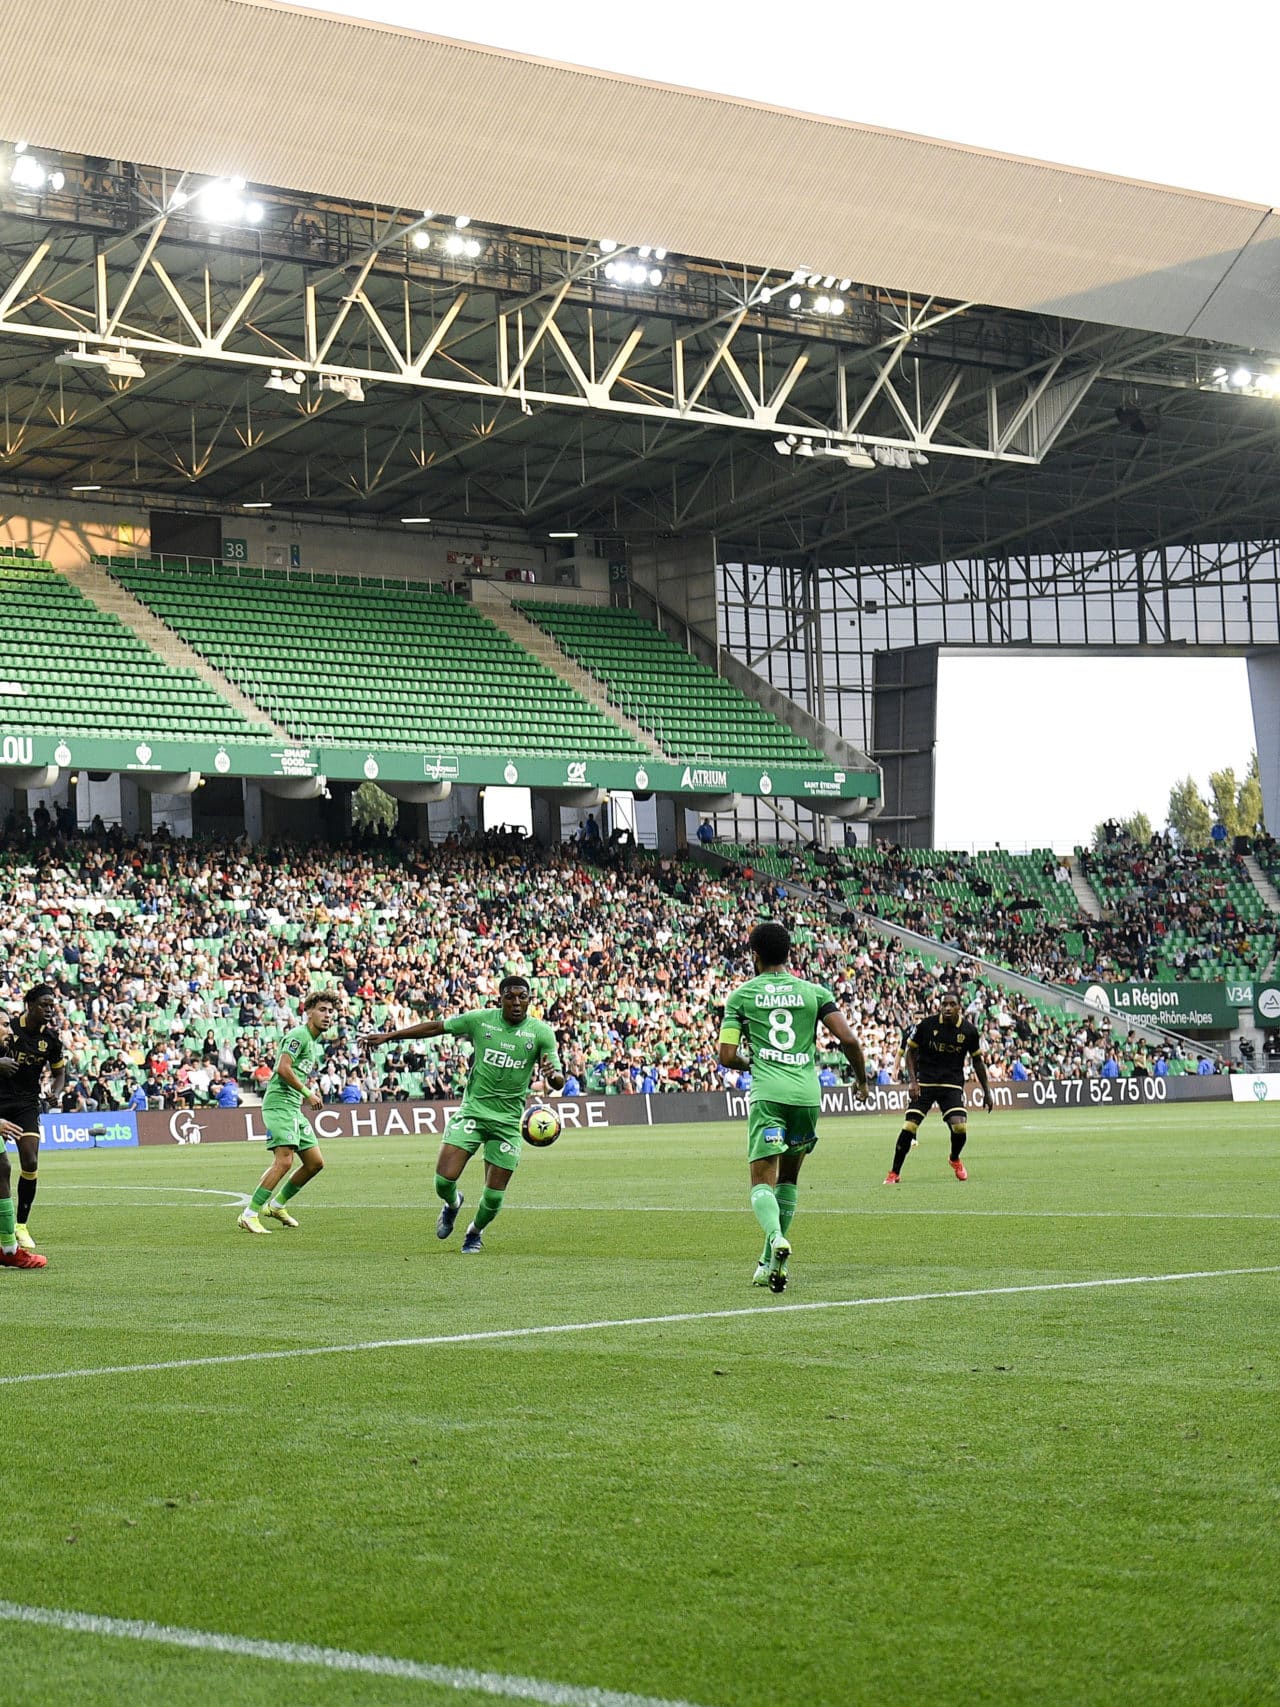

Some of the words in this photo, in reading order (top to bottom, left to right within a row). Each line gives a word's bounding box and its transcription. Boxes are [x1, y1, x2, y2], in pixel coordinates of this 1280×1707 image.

[226, 543, 244, 558] 38
[281, 757, 305, 766] GOOD
[692, 769, 727, 786] ATRIUM
[755, 993, 805, 1007] CAMARA
[1115, 988, 1129, 1006] La
[1132, 987, 1180, 1009] Région
[1227, 987, 1253, 1002] V34
[768, 1008, 796, 1051] 8
[483, 1048, 527, 1069] ZEbet
[1033, 1081, 1058, 1104] 04
[1064, 1080, 1084, 1102] 77
[1090, 1079, 1113, 1101] 52
[1120, 1078, 1140, 1100] 75
[1144, 1077, 1167, 1100] 00
[53, 1123, 90, 1143] Uber
[92, 1122, 132, 1142] Eats
[245, 1113, 268, 1141] L
[451, 1115, 477, 1134] 28
